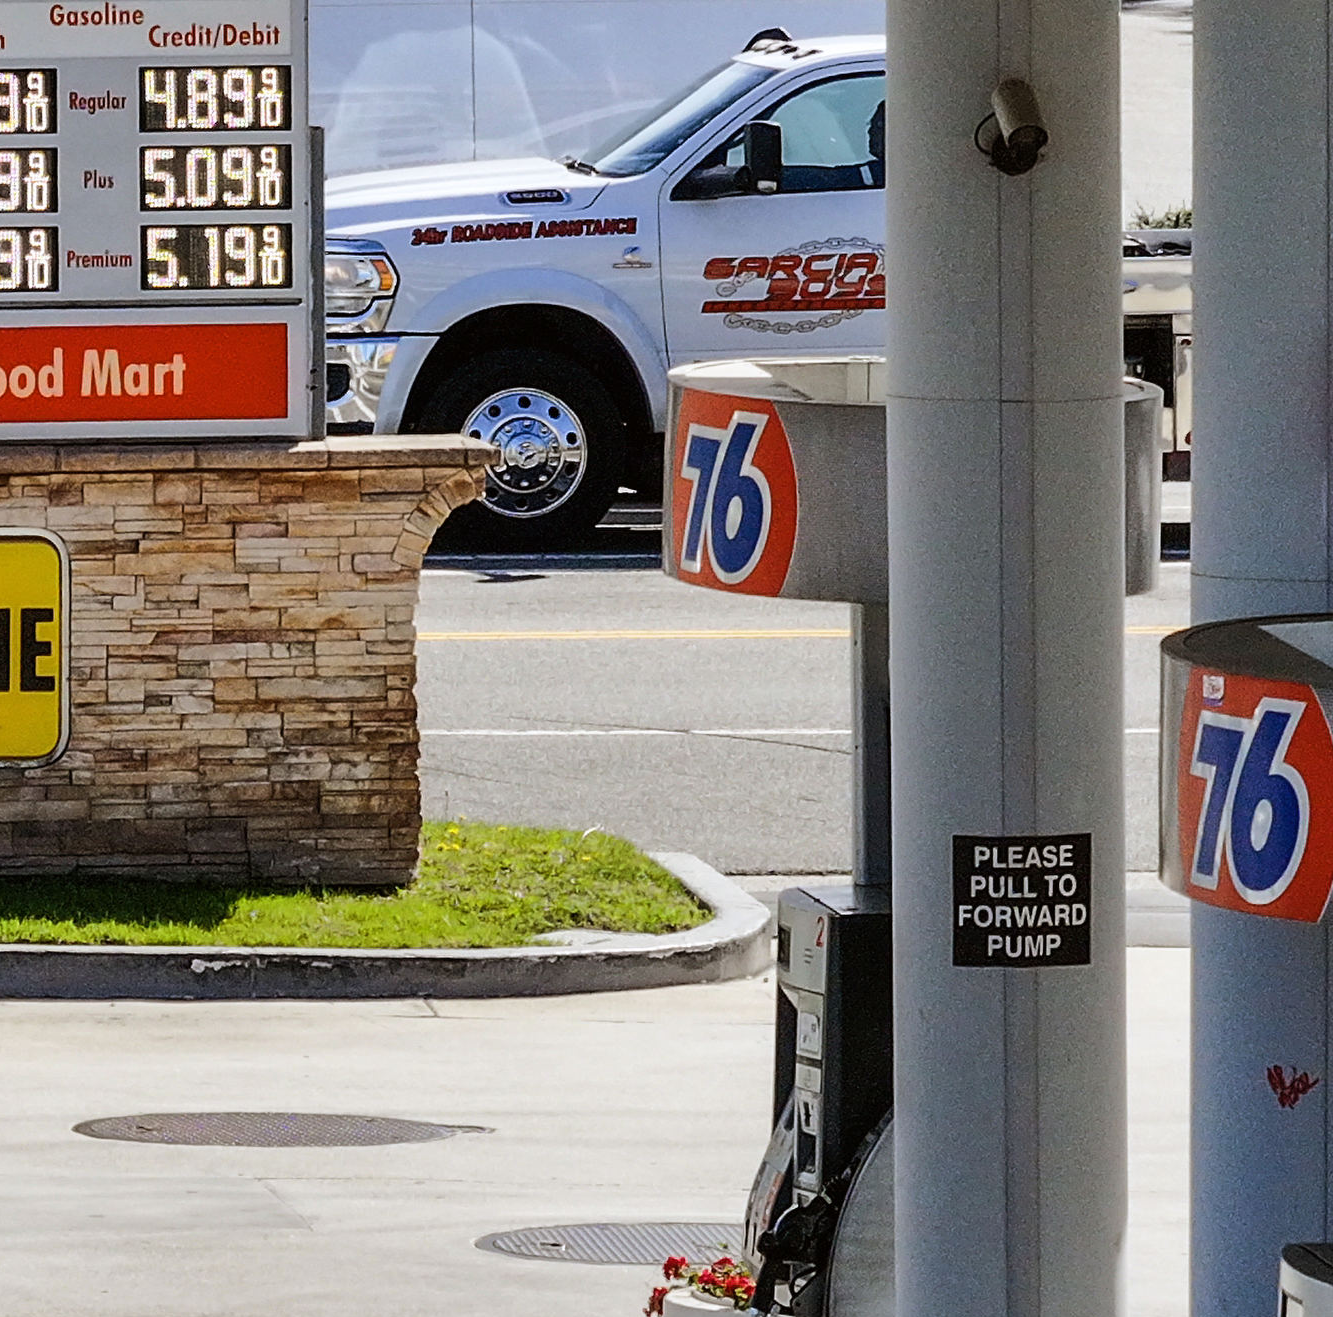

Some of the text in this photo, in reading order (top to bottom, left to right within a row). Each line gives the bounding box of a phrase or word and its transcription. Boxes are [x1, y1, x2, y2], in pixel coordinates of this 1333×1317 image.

[49, 3, 144, 27] Gasoline
[148, 22, 281, 48] Credit/Debit
[68, 91, 127, 114] Regular
[144, 69, 253, 130] 4.89
[83, 171, 114, 189] Plus
[144, 148, 253, 209] 5.09
[452, 222, 533, 243] ROADSIDE
[536, 218, 637, 237] ASSISTANCE
[67, 250, 132, 268] Premium
[146, 227, 254, 287] 5.19
[703, 254, 879, 279] GARCIA
[81, 350, 185, 396] Mart
[680, 411, 772, 584] 76
[1188, 697, 1309, 905] 76
[974, 845, 1073, 870] PLEASE
[970, 874, 1077, 899] PULL TO
[958, 902, 1087, 928] FORWARD
[987, 933, 1061, 959] PUMP
